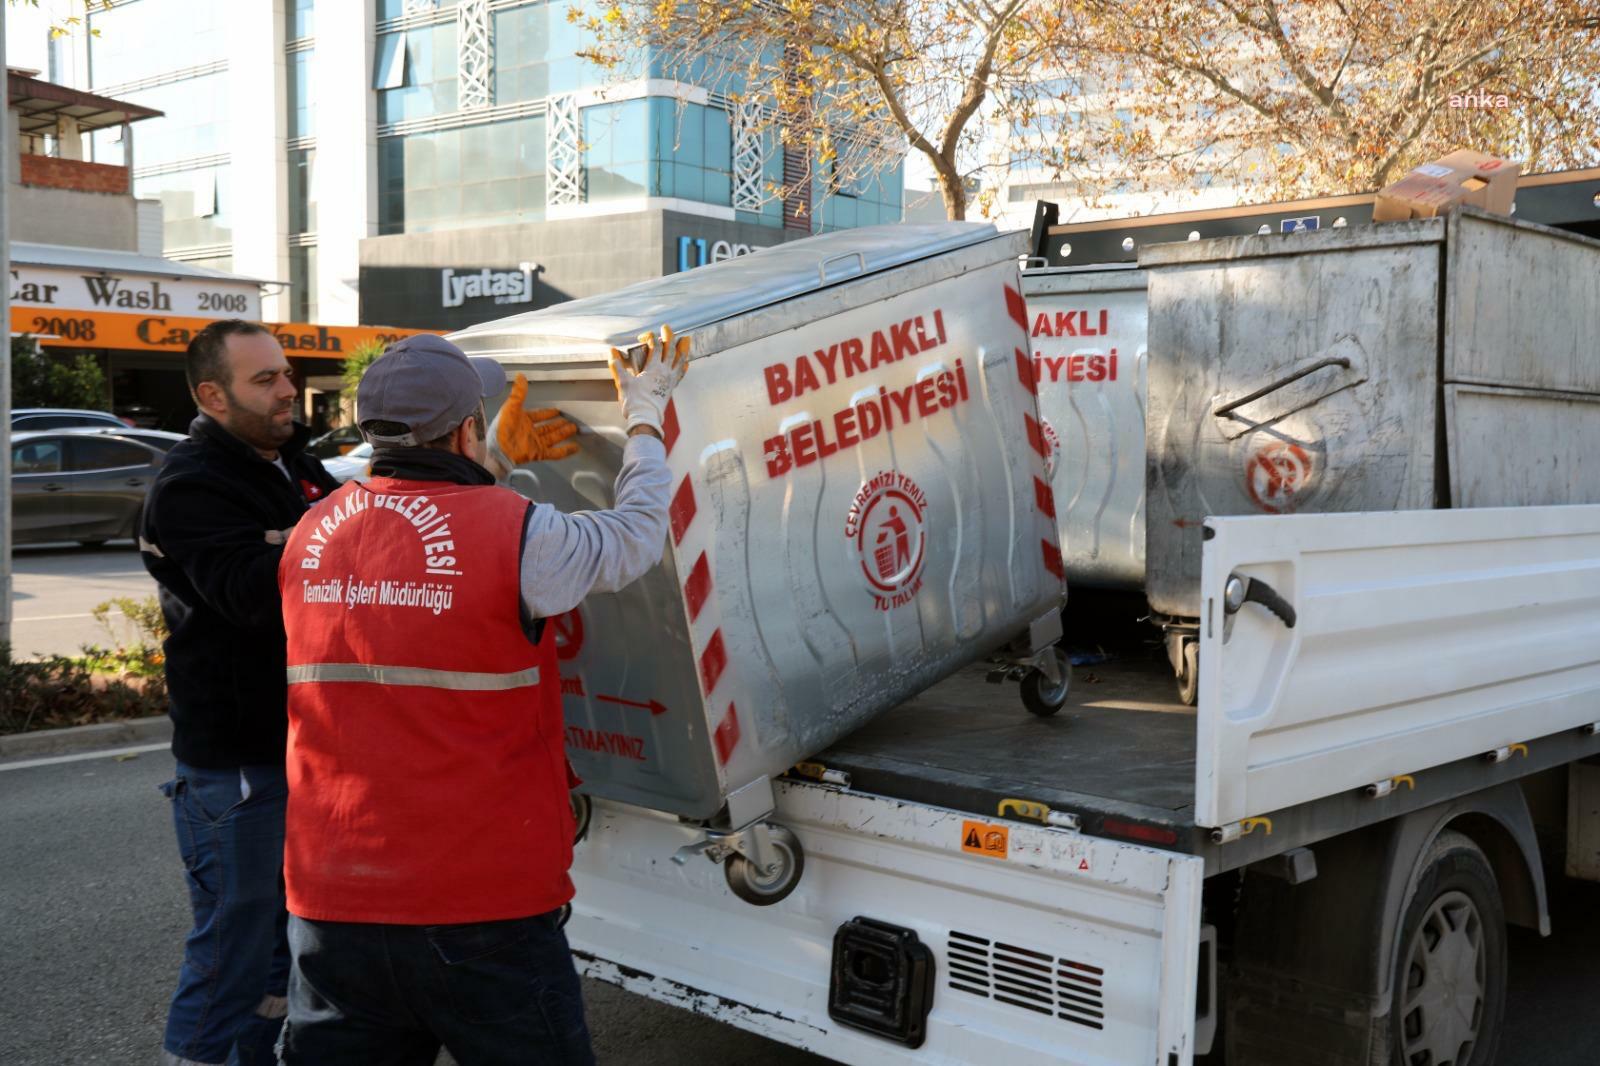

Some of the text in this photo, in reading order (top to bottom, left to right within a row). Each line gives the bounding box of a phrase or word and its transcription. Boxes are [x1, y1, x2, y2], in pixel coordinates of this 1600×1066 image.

[81, 275, 172, 311] Wash
[198, 292, 248, 314] 2008
[32, 316, 97, 342] 2008
[137, 317, 200, 346] Ca
[271, 323, 343, 353] ash
[1032, 309, 1109, 338] AKLI
[763, 308, 948, 406] BAYRAKLI
[763, 358, 969, 479] BELEDİYESİ
[301, 488, 370, 570] BAYRAKLI
[845, 469, 928, 538] ÇEVREMİZİ TEMİZ
[302, 574, 453, 616] Temizlik İşleri Müdürlüğü
